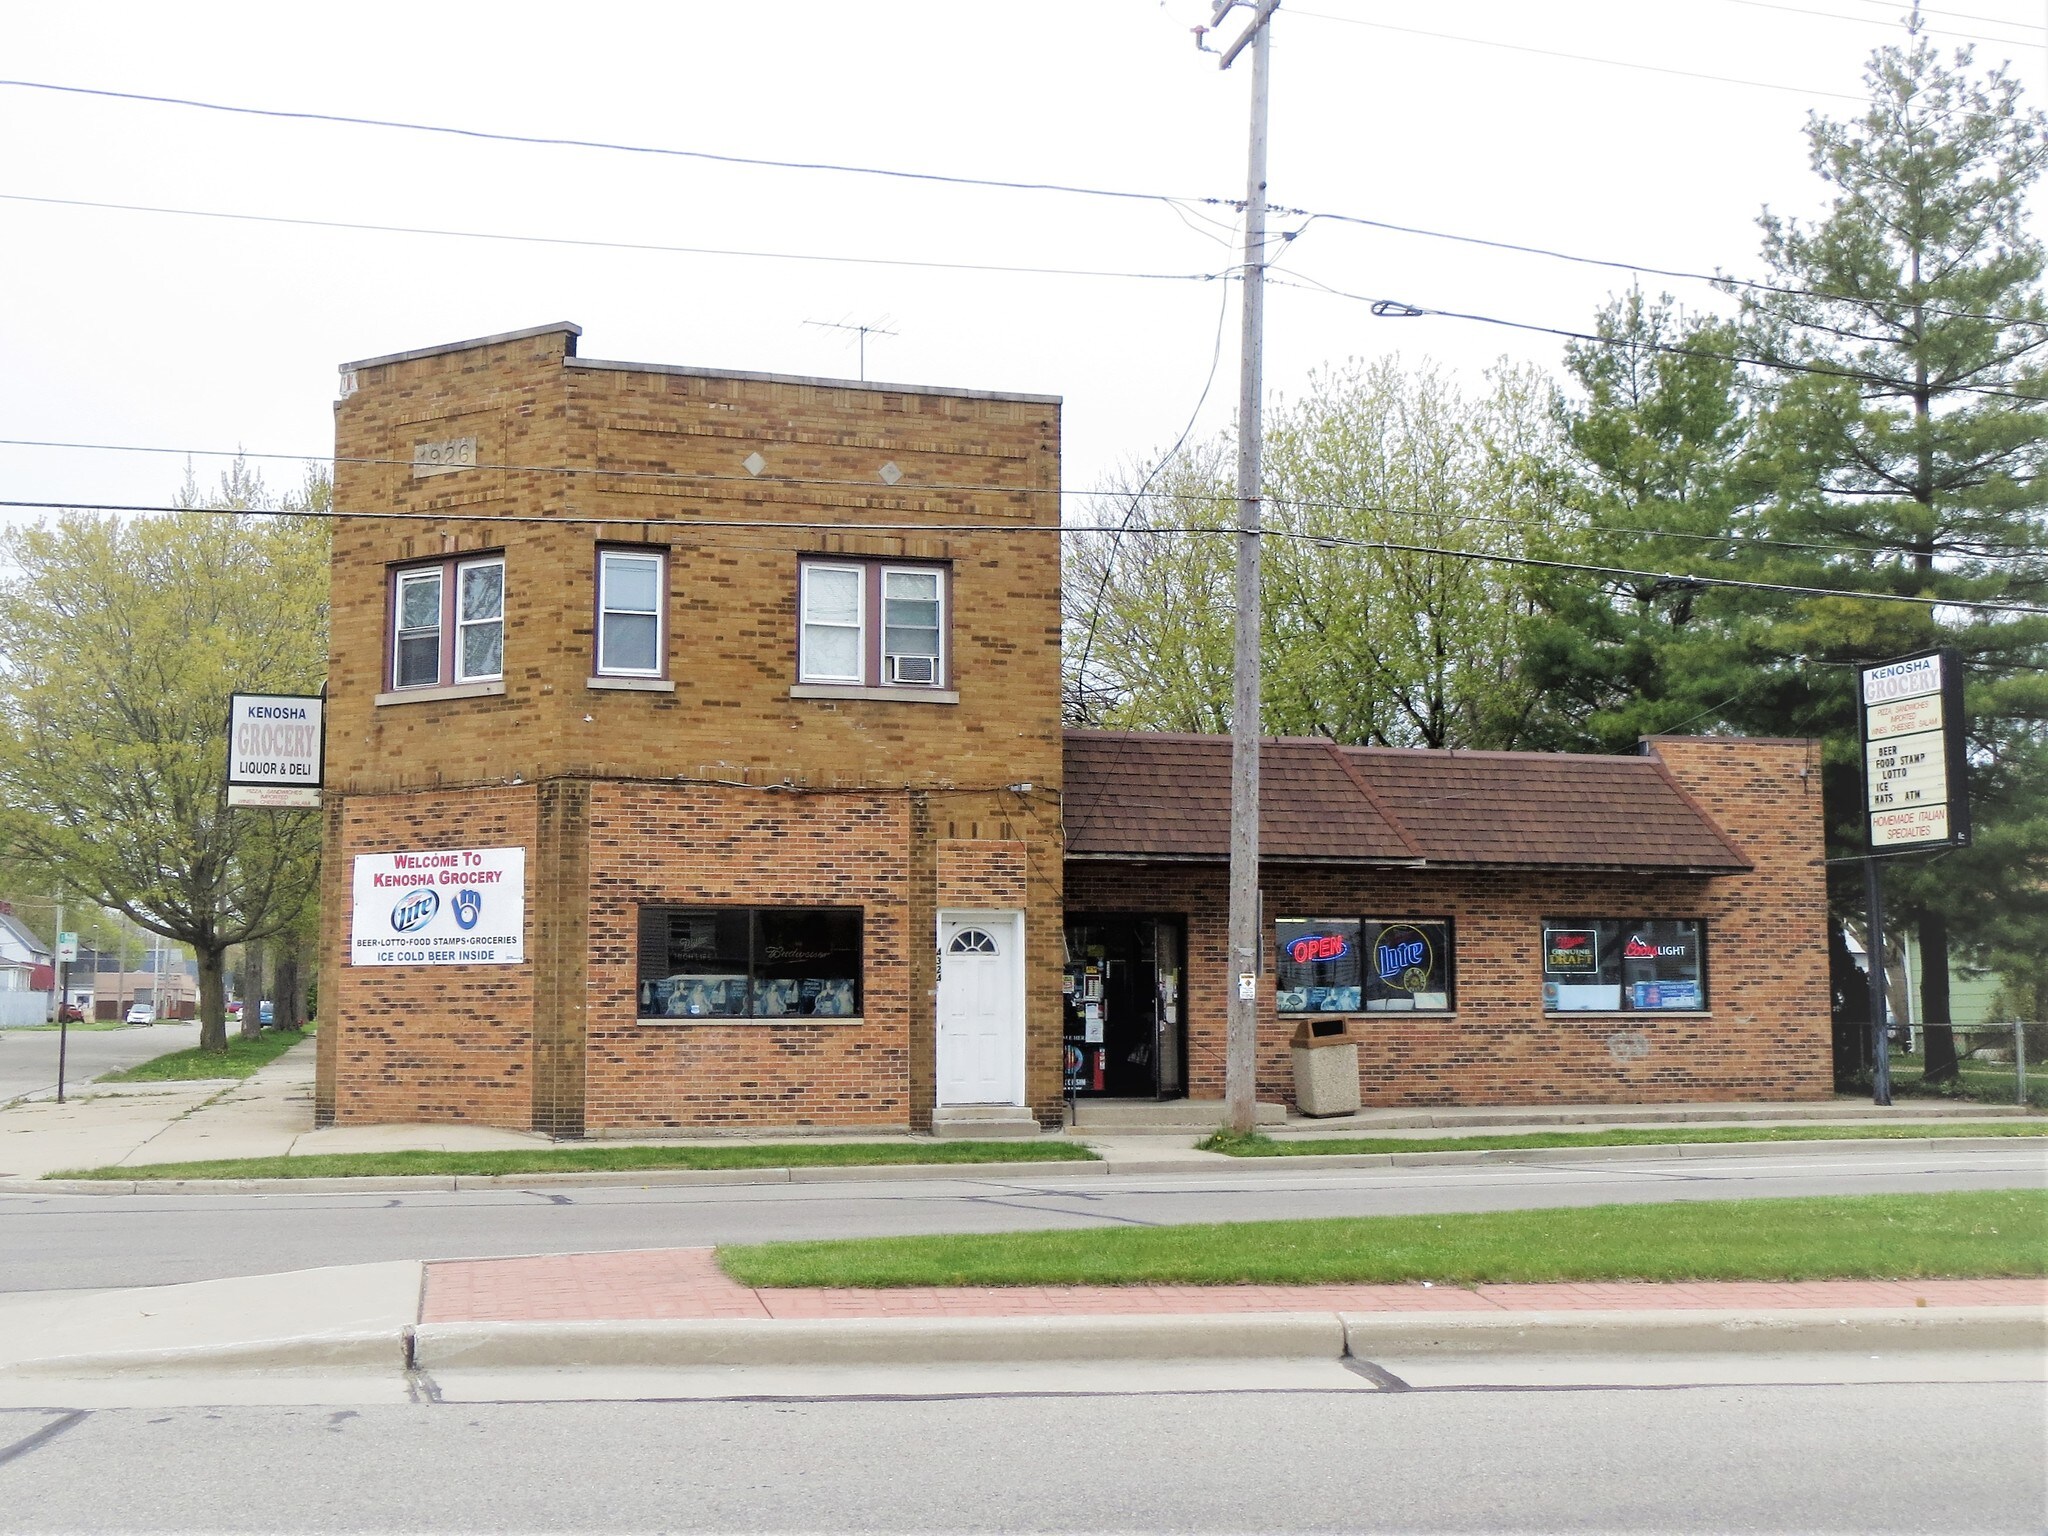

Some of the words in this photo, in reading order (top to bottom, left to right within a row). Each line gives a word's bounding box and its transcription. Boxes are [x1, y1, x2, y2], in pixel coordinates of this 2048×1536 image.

[1872, 660, 1931, 680] KENOSHA
[1866, 669, 1939, 701] GROCERY
[248, 706, 306, 720] KENOSHA
[238, 722, 316, 758] GROCERY
[1878, 745, 1898, 757] BEER
[1876, 757, 1895, 769] FOOD
[1900, 752, 1926, 766] STAMP
[240, 761, 277, 775] LIQUOR
[279, 762, 287, 775] &
[289, 763, 311, 776] DELI
[1882, 767, 1907, 780] LOTTO
[1876, 782, 1889, 792] ICE
[1904, 789, 1921, 801] ATM
[1873, 812, 1915, 827] HOMEMADE
[1918, 808, 1945, 821] ITALIAN
[1887, 825, 1931, 840] SPECIALTIES
[394, 854, 459, 869] WELCOME
[462, 852, 482, 867] TO
[373, 873, 435, 887] KENOSHA
[438, 870, 503, 885] GROCERY
[377, 951, 394, 961] ICE
[398, 951, 425, 961] COLD
[428, 950, 456, 961] BEER
[459, 950, 495, 960] INSIDE
[765, 946, 831, 959] Budweiser
[1293, 935, 1345, 963] OPEN
[1551, 948, 1591, 956] GENUINE
[1625, 941, 1658, 957] Coors
[1657, 945, 1686, 956] LIGHT
[1378, 942, 1423, 978] Lite
[1549, 954, 1594, 966] DRAFT
